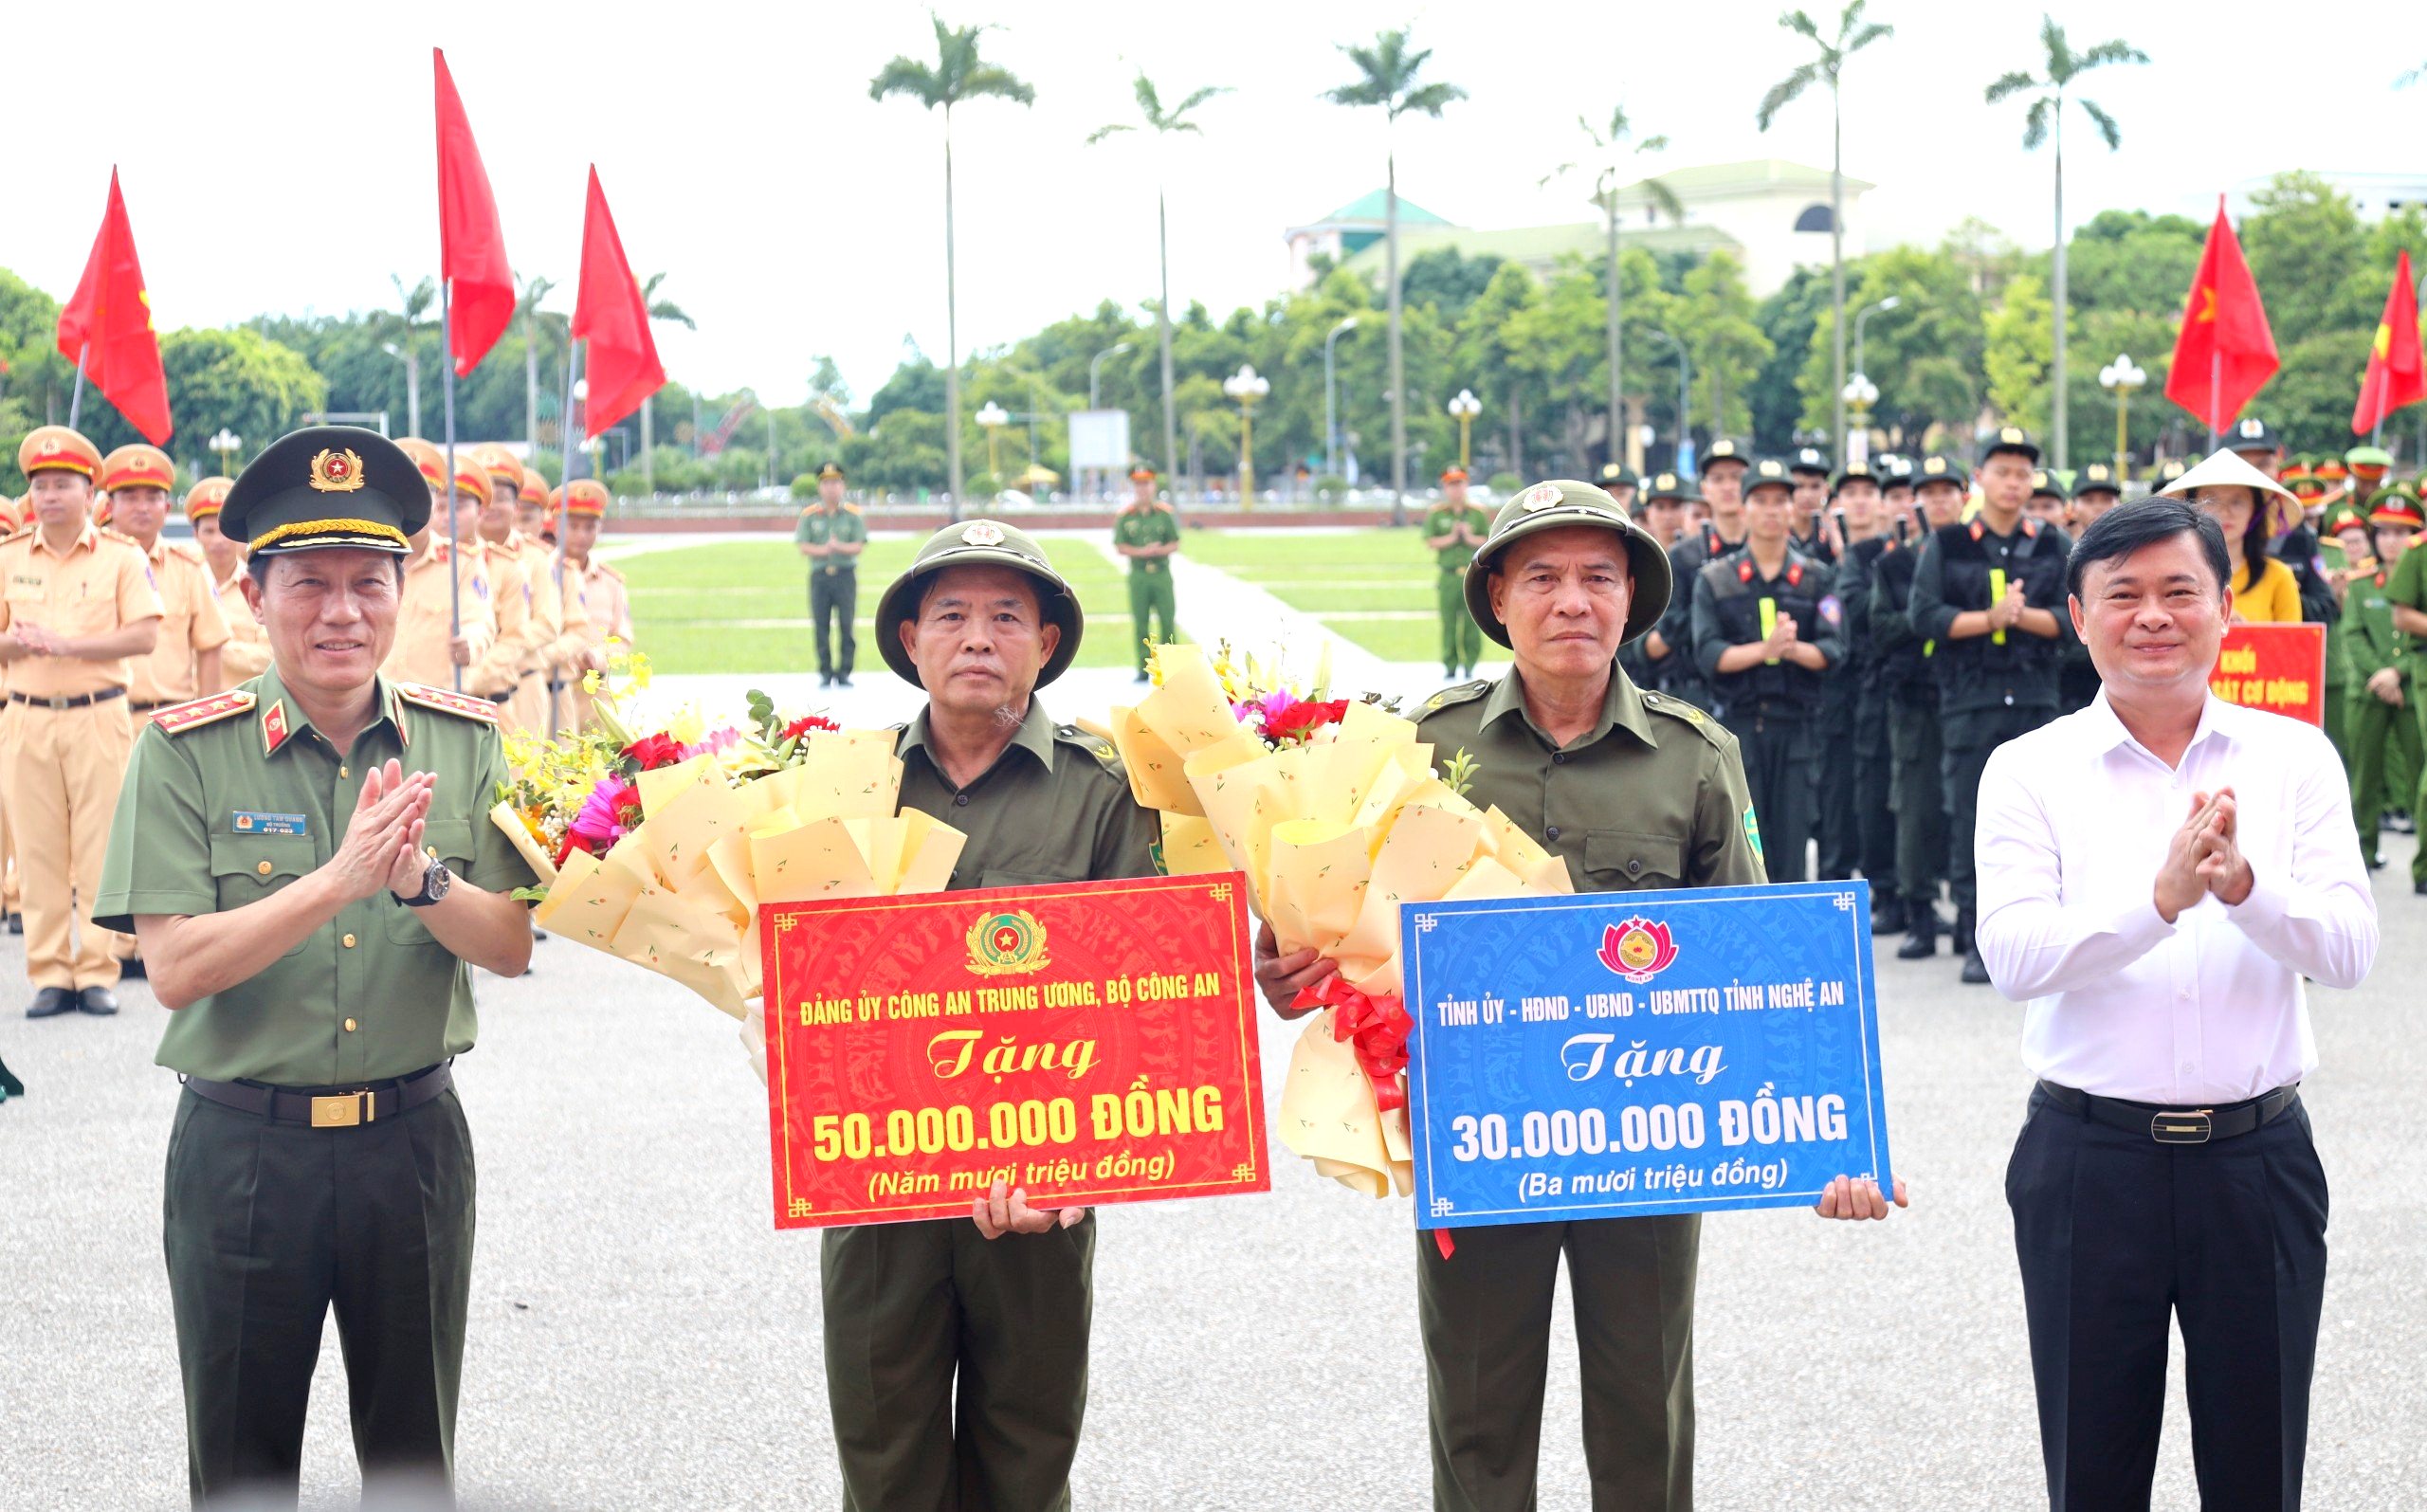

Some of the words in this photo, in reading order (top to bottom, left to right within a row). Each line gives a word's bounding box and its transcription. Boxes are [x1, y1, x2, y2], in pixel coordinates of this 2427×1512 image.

[2242, 678, 2265, 704] CƠ
[2265, 676, 2309, 710] ĐỘNG
[799, 992, 853, 1027] ĐẢNG
[857, 989, 882, 1022] ỦY
[887, 989, 940, 1020] CÔNG
[945, 990, 972, 1016] AN
[976, 985, 1039, 1013] TRUNG
[1043, 980, 1102, 1009] ƯƠNG,
[1105, 973, 1132, 1009] BỘ
[1136, 971, 1189, 1002] CÔNG
[1194, 972, 1220, 998] AN
[1437, 993, 1478, 1027] TỈNH
[1482, 991, 1505, 1025] ỦY
[1521, 995, 1570, 1023] HĐND
[1585, 992, 1633, 1019] UBND
[1650, 986, 1720, 1016] UBMTTQ
[1724, 978, 1764, 1011] TỈNH
[1768, 977, 1816, 1012] NGHỆ
[1819, 980, 1845, 1007] AN
[926, 1029, 1102, 1084] Tặng
[1560, 1032, 1729, 1088] Tặng
[813, 1097, 1077, 1162] 50.000.000
[1090, 1074, 1225, 1140] ĐỒNG
[1451, 1103, 1706, 1162] 30.000.000
[1718, 1082, 1848, 1147] ĐỒNG
[868, 1170, 940, 1203] (Năm
[949, 1161, 1017, 1191] mươi
[1026, 1157, 1087, 1189] triệu
[1095, 1149, 1175, 1181] đồng)
[1518, 1172, 1563, 1203] (Ba
[1571, 1167, 1636, 1194] mươi
[1644, 1163, 1704, 1193] triệu
[1711, 1157, 1788, 1191] đồng)
